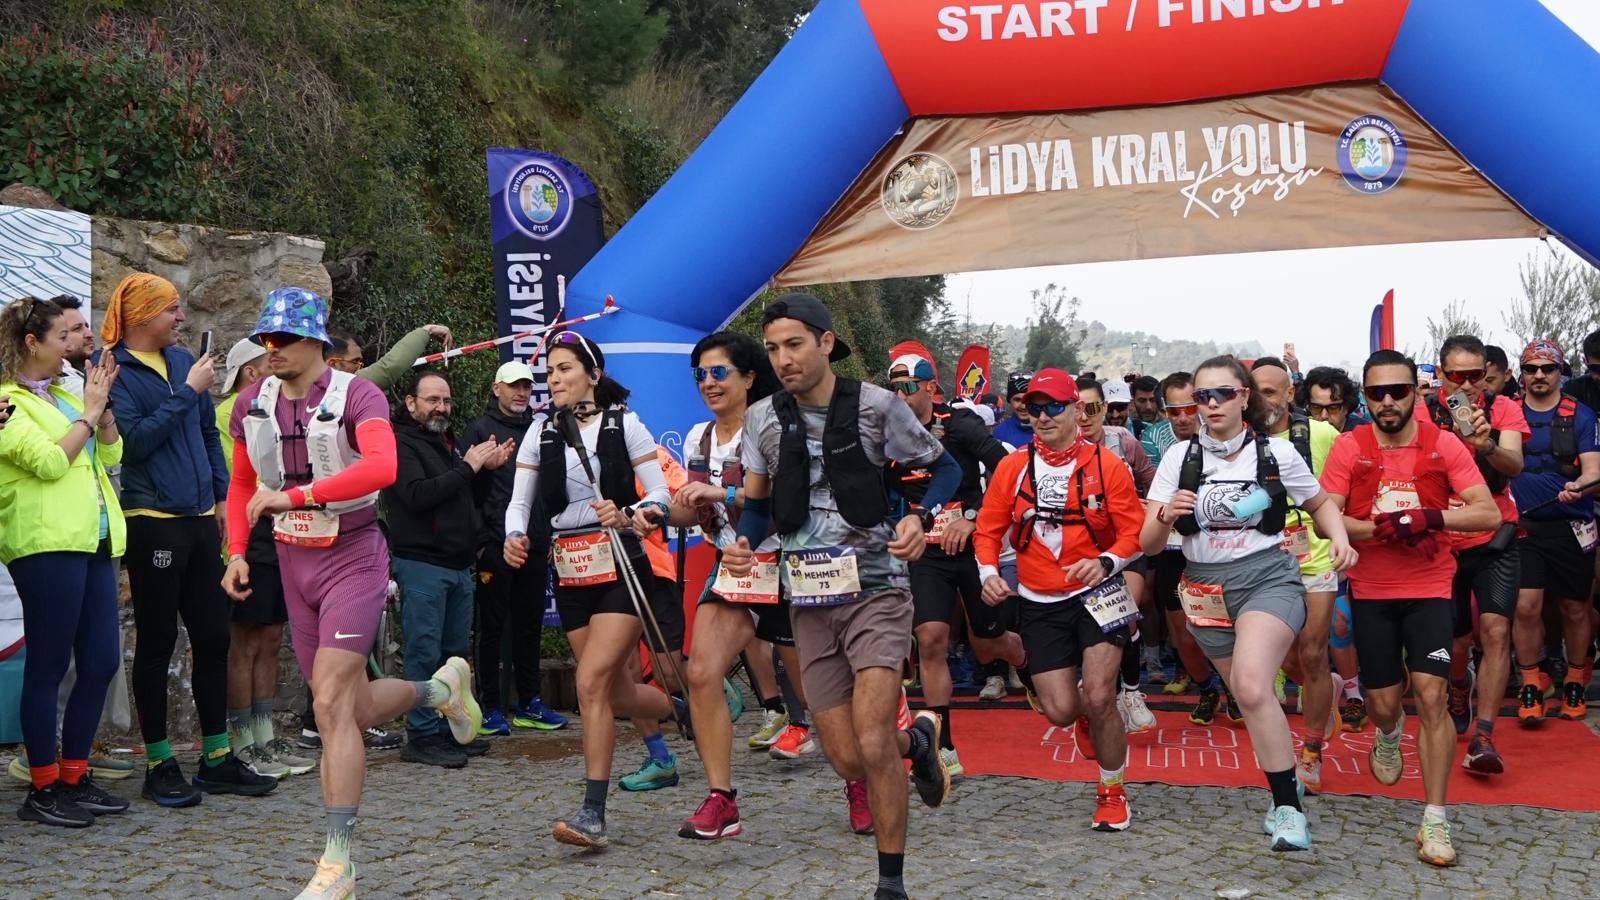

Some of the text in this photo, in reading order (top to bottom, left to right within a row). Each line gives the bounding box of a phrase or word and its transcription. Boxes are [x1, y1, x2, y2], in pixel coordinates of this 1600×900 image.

[937, 2, 1108, 42] START
[1158, 0, 1344, 27] FIN
[1092, 131, 1195, 187] KRAL
[1202, 121, 1307, 177] YOLU
[1364, 181, 1383, 190] 1879
[1395, 500, 1411, 508] 197
[288, 511, 313, 521] ENES
[294, 523, 310, 532] 123
[569, 554, 593, 564] ALİYE
[803, 552, 832, 560] LİDYA
[575, 565, 588, 573] 187
[791, 569, 801, 577] 40
[804, 570, 840, 579] MEHMET
[736, 581, 752, 589] 128
[818, 581, 830, 589] 73
[1104, 594, 1128, 608] HASAN
[1118, 605, 1127, 613] 49
